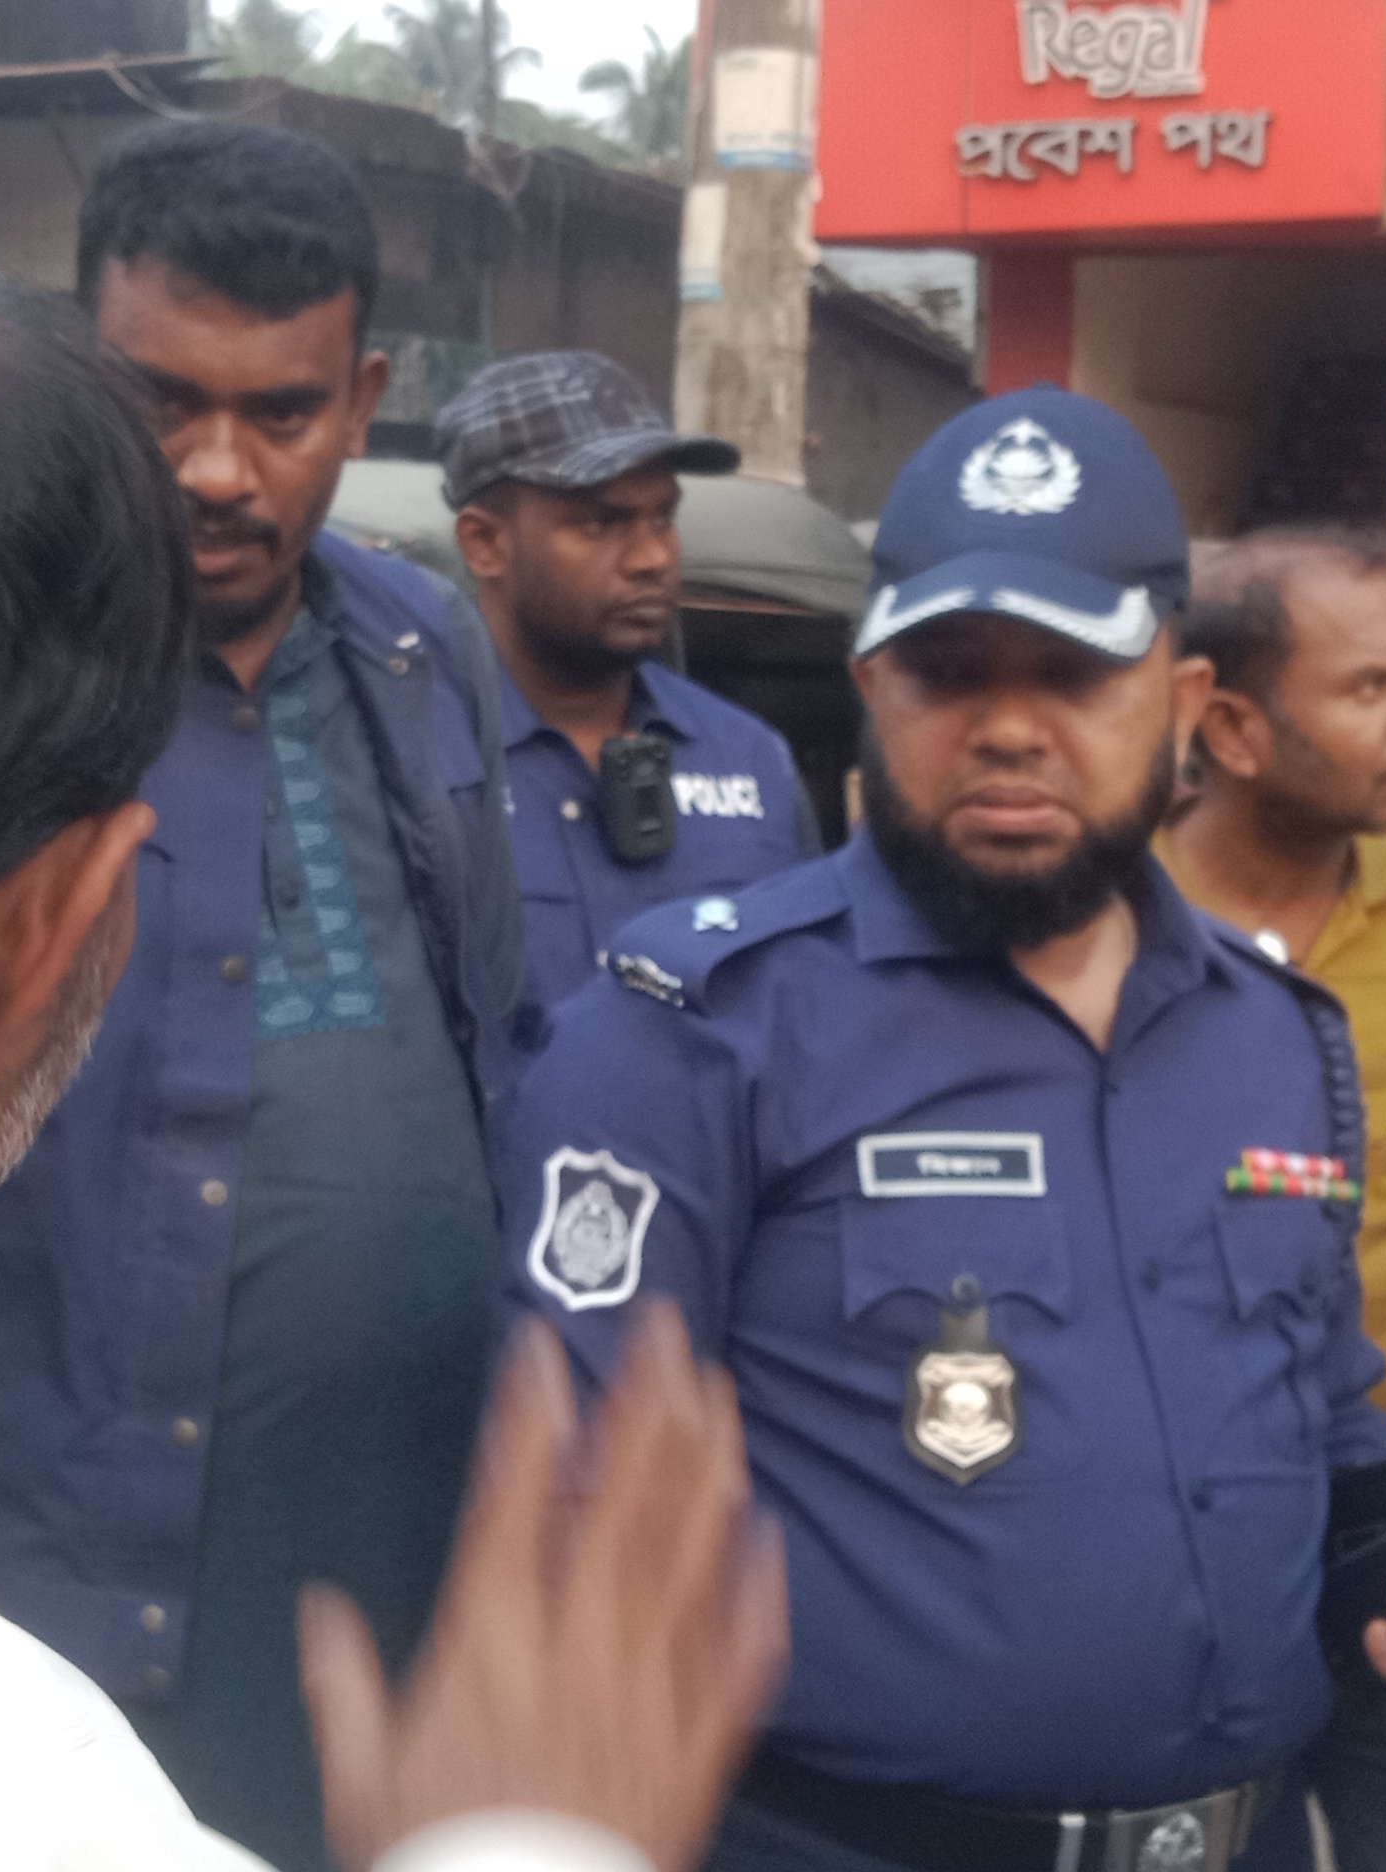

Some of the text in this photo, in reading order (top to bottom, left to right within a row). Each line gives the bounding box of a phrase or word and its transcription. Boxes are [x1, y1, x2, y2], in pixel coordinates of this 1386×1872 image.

[1016, 0, 1208, 98] Regal
[955, 109, 1272, 181] প্রবেশ পথ
[670, 772, 764, 819] POLICE
